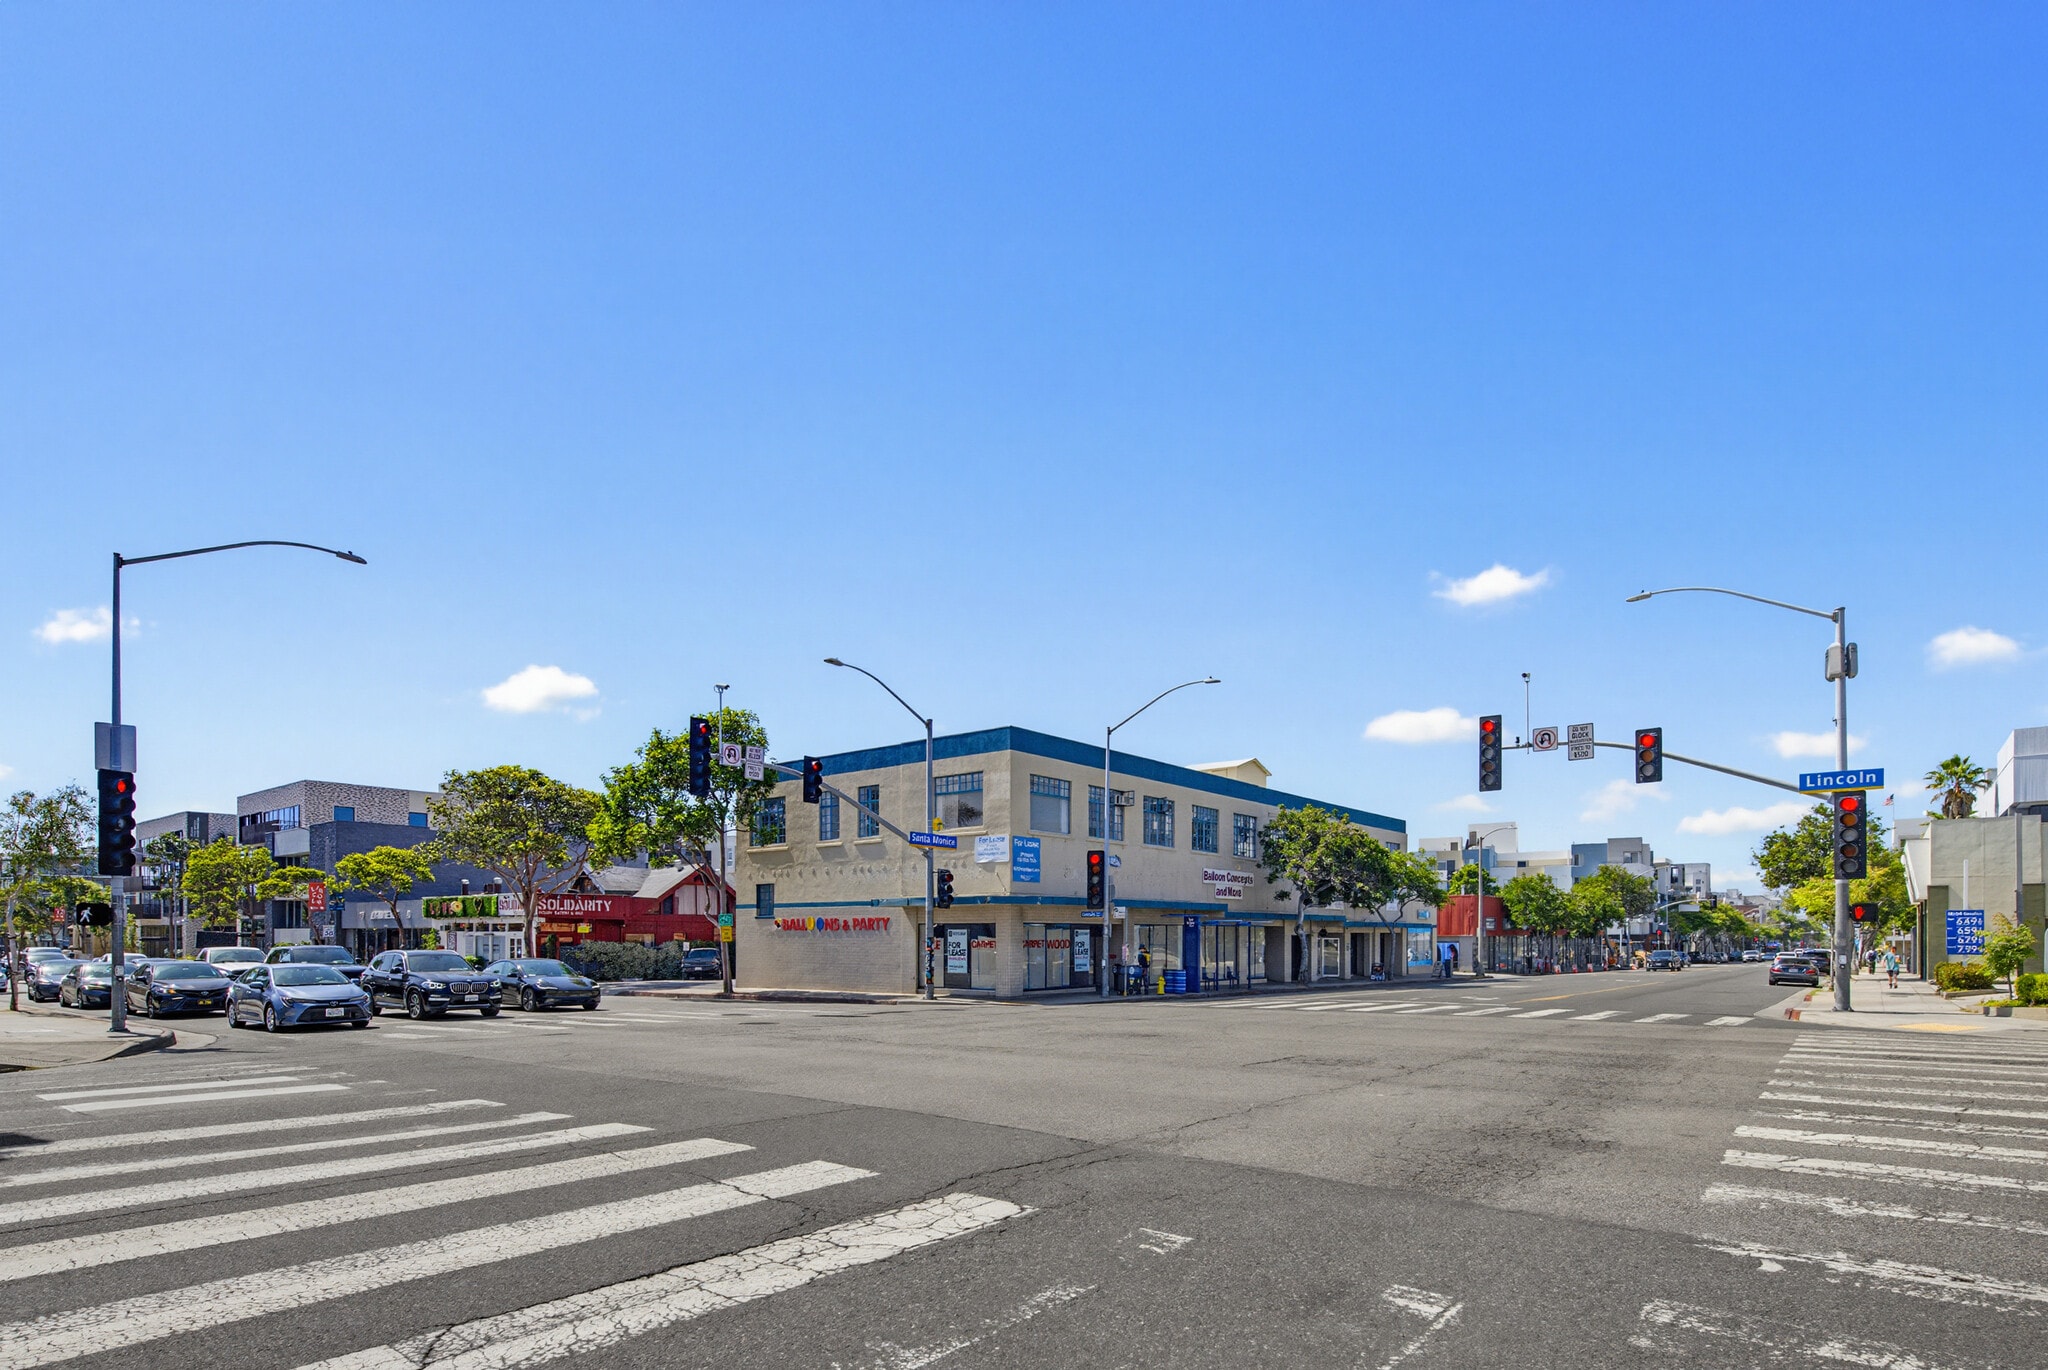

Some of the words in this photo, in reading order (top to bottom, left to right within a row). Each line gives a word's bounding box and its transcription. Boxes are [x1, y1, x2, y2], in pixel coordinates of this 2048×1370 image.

[1806, 771, 1876, 787] Lincoln
[912, 833, 930, 844] Santa
[932, 835, 955, 846] Monica
[1014, 838, 1024, 847] For
[1203, 870, 1225, 882] Balloon
[1226, 872, 1253, 885] Concepts
[1216, 887, 1227, 896] and
[1228, 887, 1242, 897] More
[537, 898, 612, 912] SOLIDARITY
[842, 920, 850, 932] &
[852, 918, 890, 931] PARTY
[948, 941, 961, 949] FOR
[1047, 939, 1071, 949] WOOD
